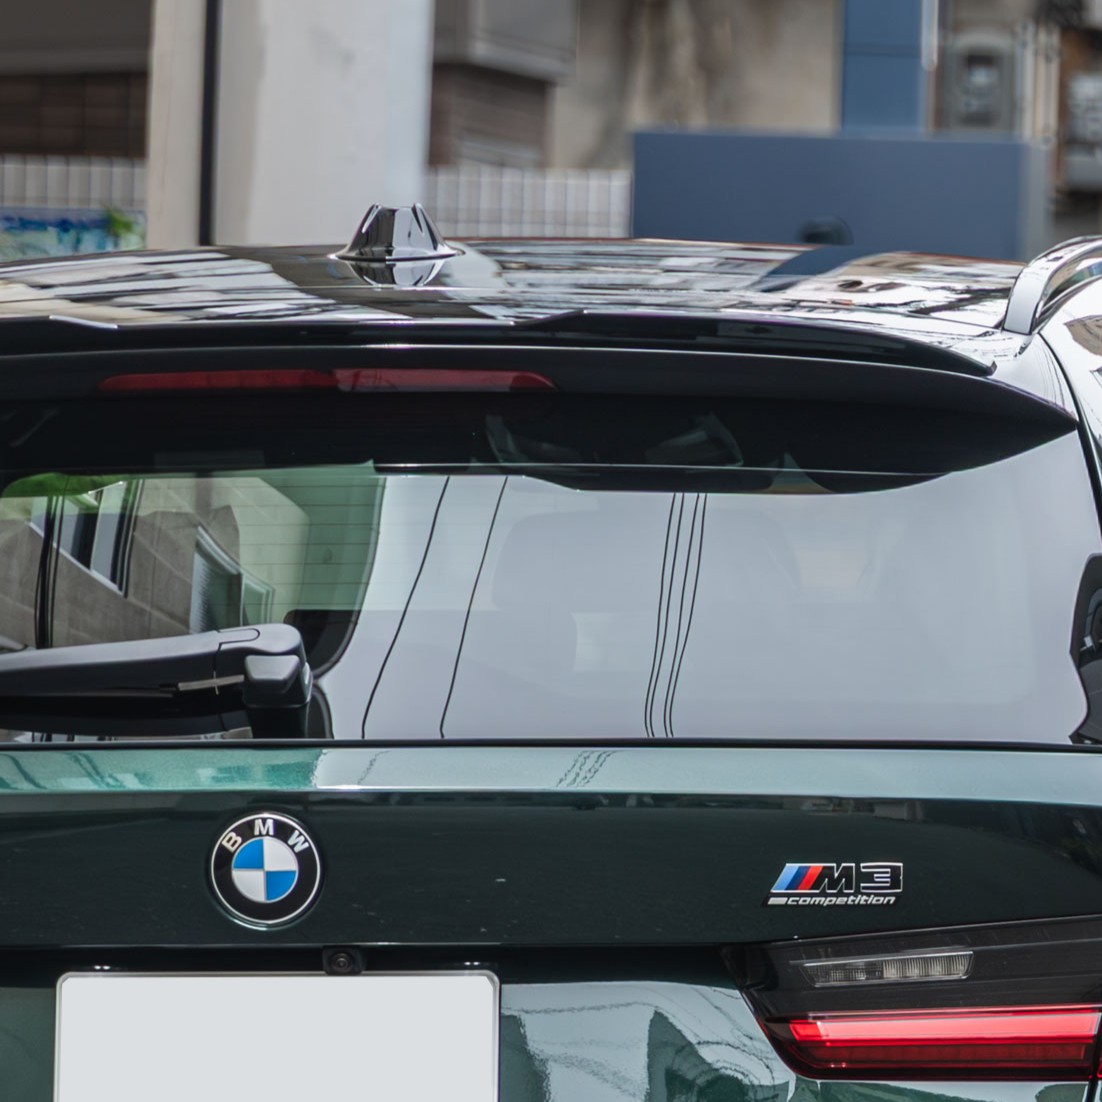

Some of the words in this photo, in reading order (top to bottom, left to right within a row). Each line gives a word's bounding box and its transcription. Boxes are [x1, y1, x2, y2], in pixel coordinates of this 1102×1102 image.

[222, 818, 310, 853] BMW
[807, 862, 903, 893] M3
[787, 894, 896, 907] competition
